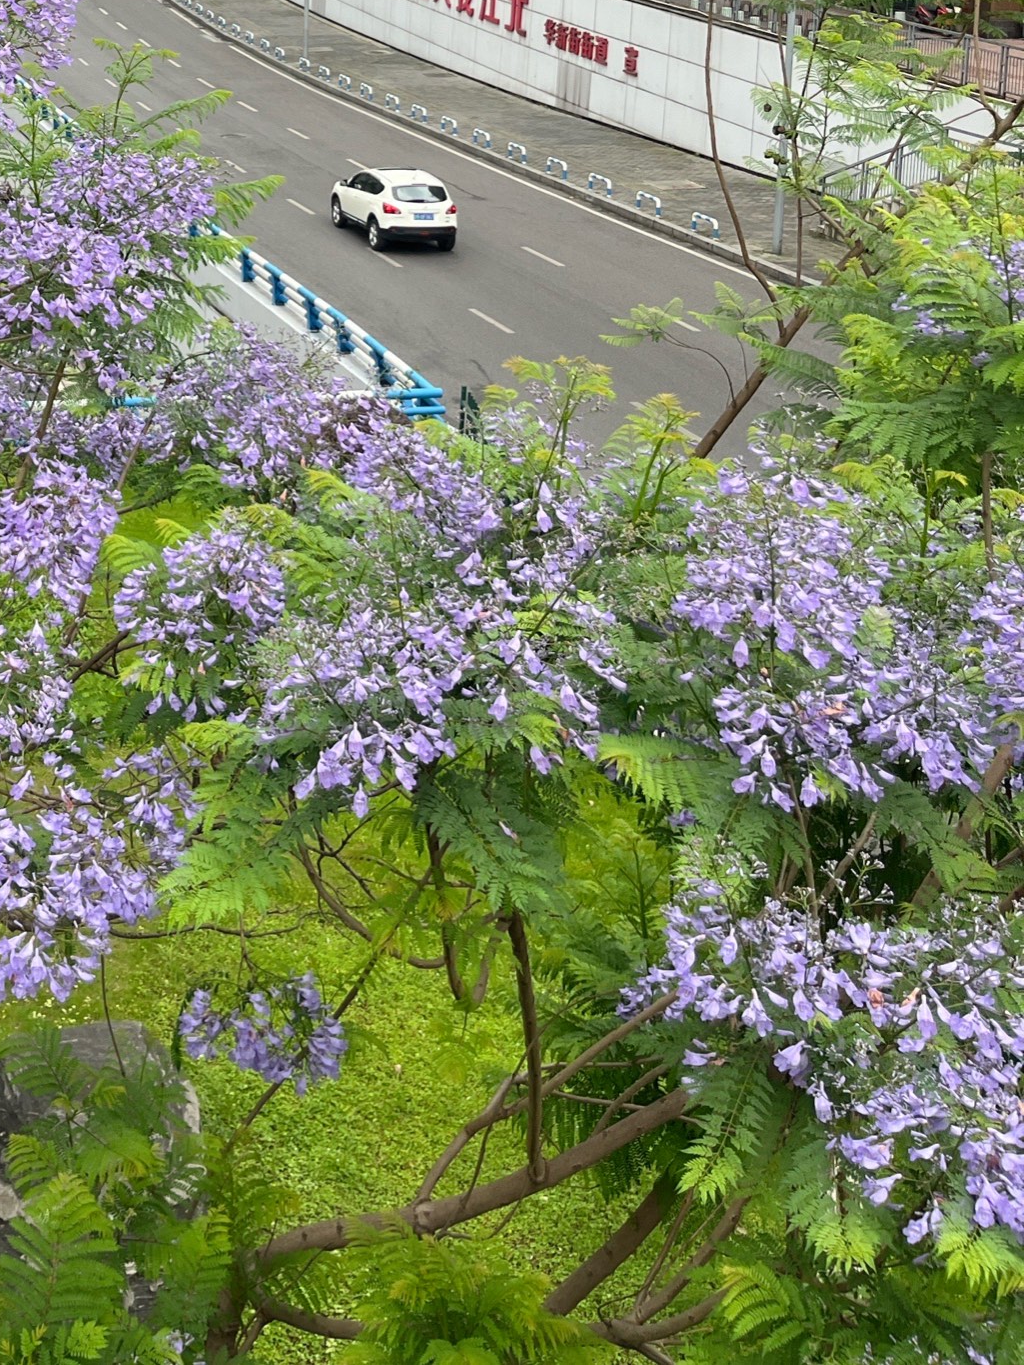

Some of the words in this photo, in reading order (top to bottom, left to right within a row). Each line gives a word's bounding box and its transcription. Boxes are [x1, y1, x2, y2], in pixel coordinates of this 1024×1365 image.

[543, 18, 609, 67] 华新街街道
[622, 46, 640, 78] 宣
